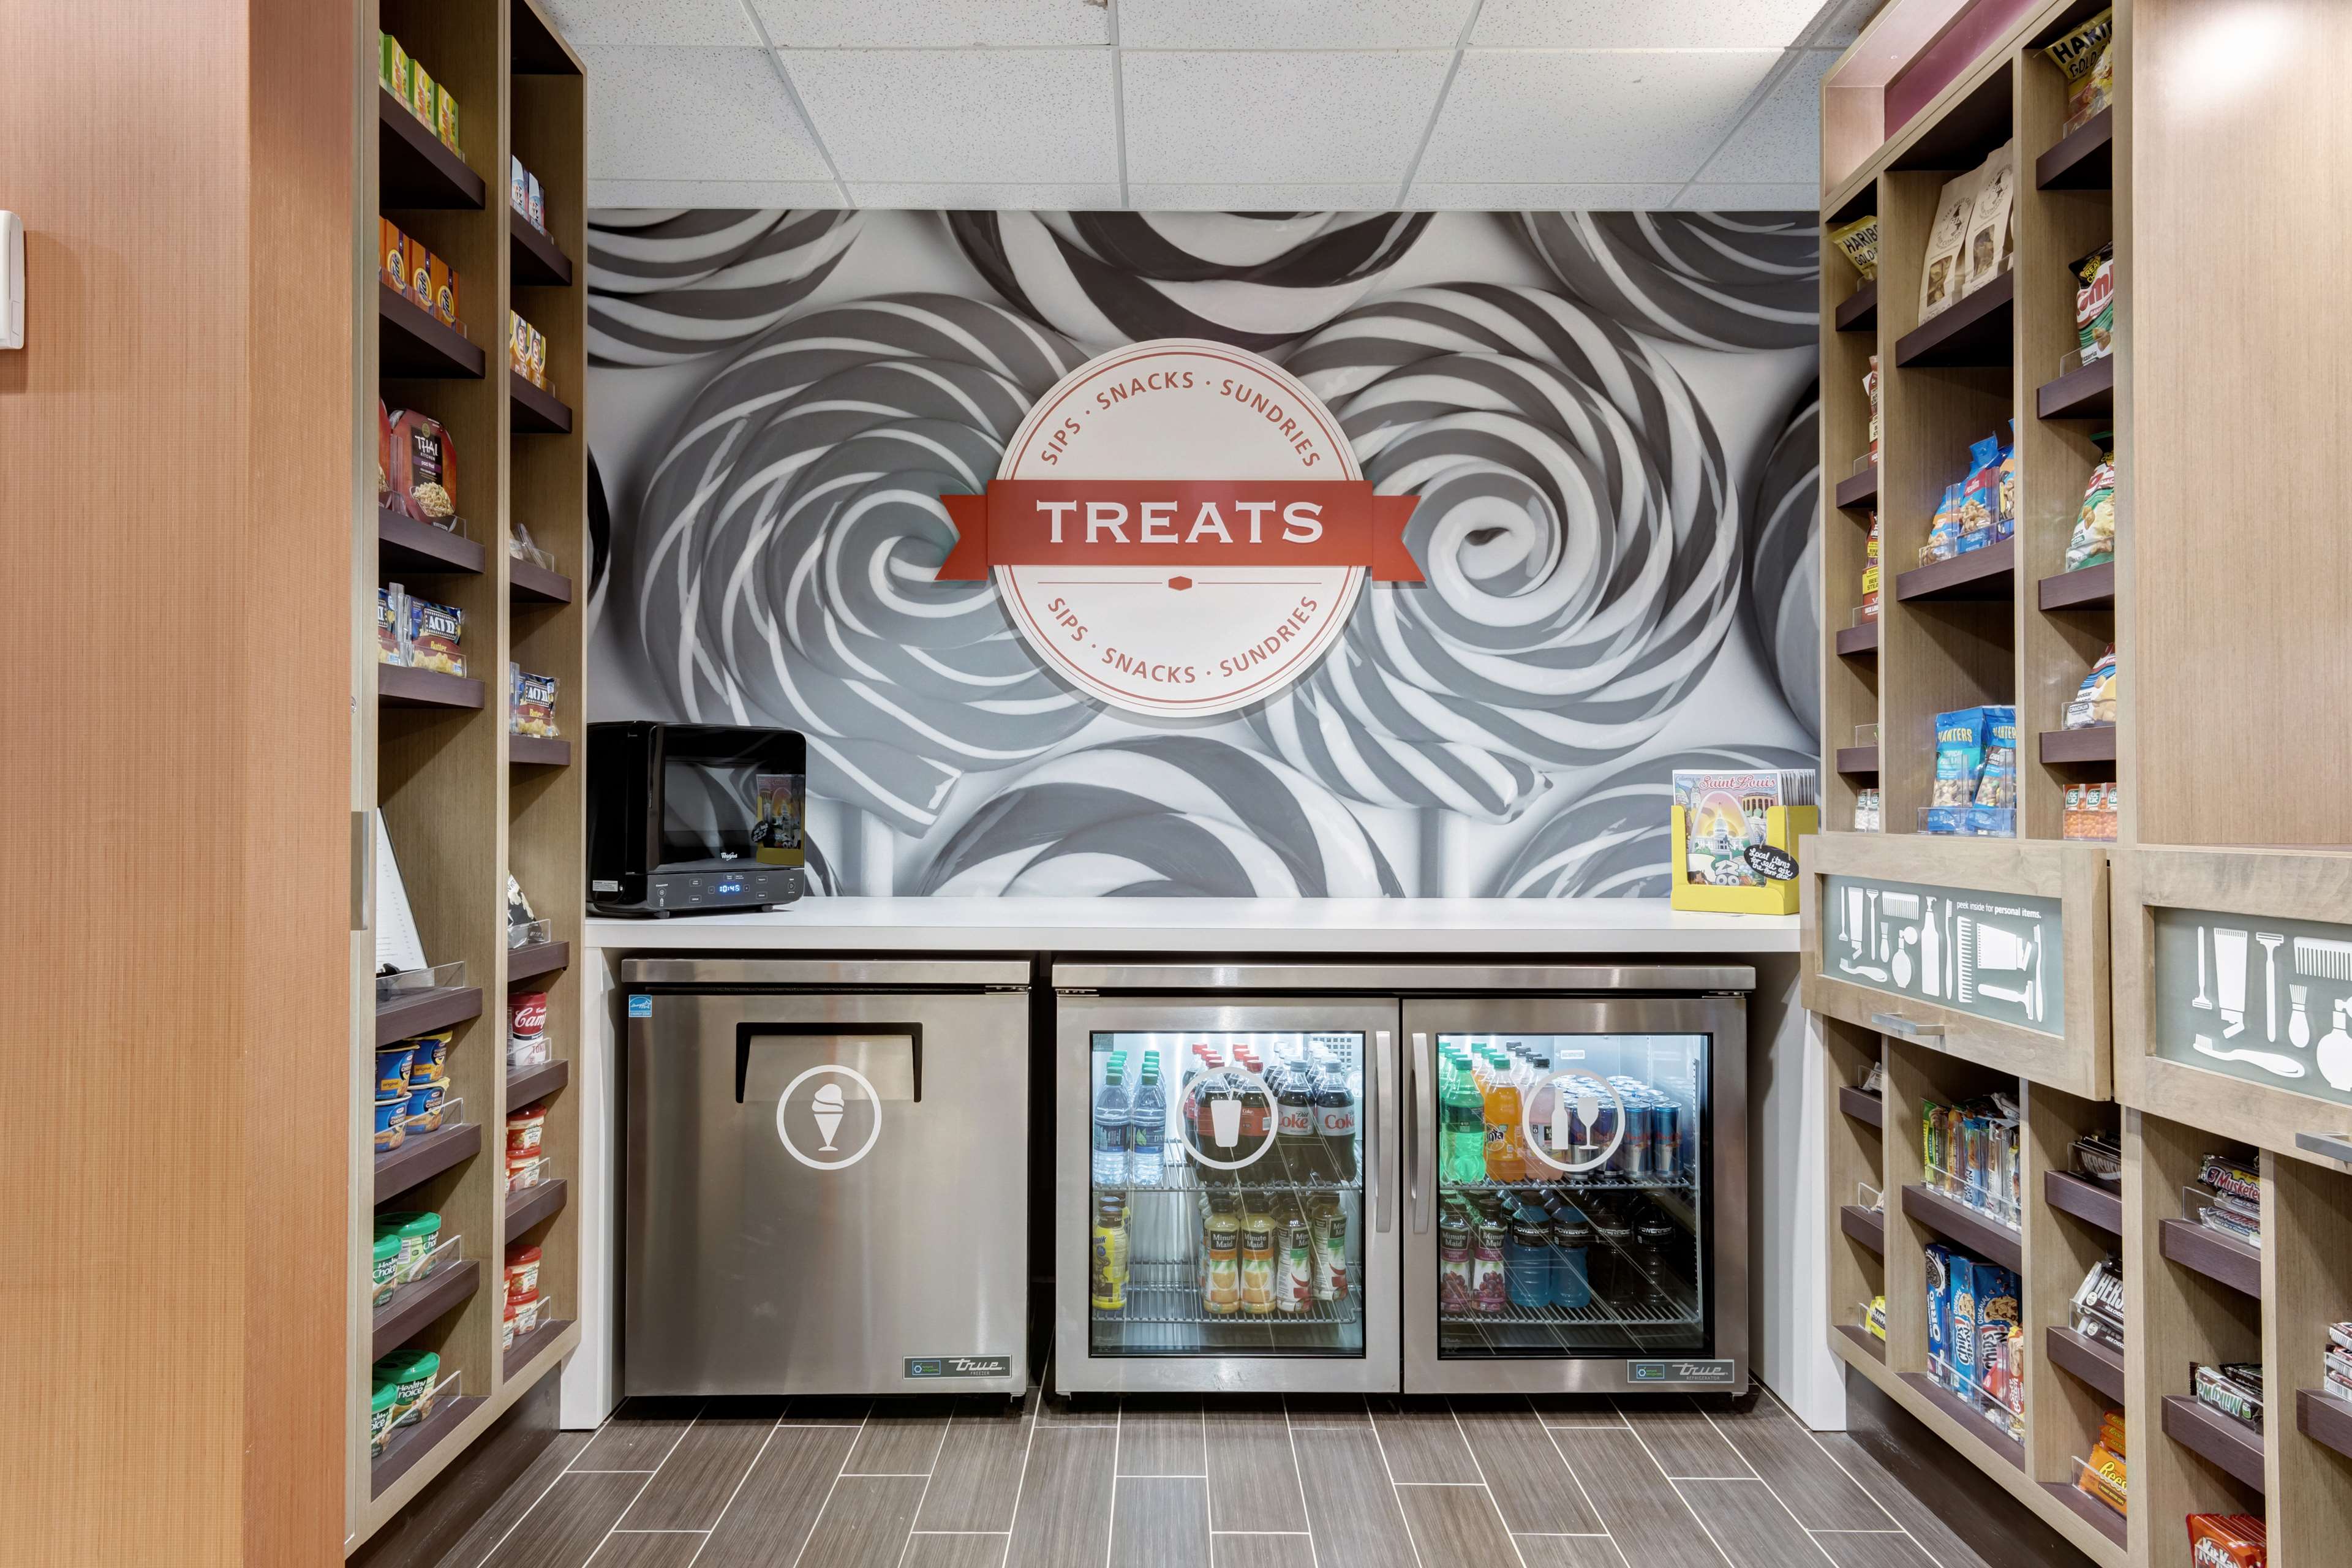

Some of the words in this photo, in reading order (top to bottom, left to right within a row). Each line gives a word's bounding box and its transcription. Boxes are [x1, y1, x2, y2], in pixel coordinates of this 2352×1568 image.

[1041, 417, 1081, 466] SIPS
[1096, 371, 1194, 410] SNACKS
[1219, 379, 1321, 467] SUNDRIES
[415, 435, 439, 456] THAI
[1036, 499, 1324, 544] TREATS
[1047, 597, 1088, 641] SIPS
[1101, 647, 1196, 684] SNACKS
[1219, 596, 1318, 677] SUNDRIES
[1699, 775, 1735, 790] Saint
[1734, 775, 1776, 790] Louis
[1749, 848, 1770, 861] Local
[1771, 856, 1790, 869] items
[1752, 862, 1764, 871] the
[1760, 860, 1777, 870] sale
[1777, 867, 1793, 876] ask
[1957, 901, 1969, 910] peek
[1969, 902, 1985, 911] inside
[1985, 903, 1994, 912] for
[1994, 907, 2021, 915] personal
[2022, 908, 2041, 919] items.
[2209, 1169, 2218, 1182] 3
[1513, 1226, 1549, 1234] POWERADE
[1929, 1291, 1942, 1343] OREO
[1977, 1295, 1991, 1325] ORIGINAL
[1956, 1325, 1969, 1365] Chips
